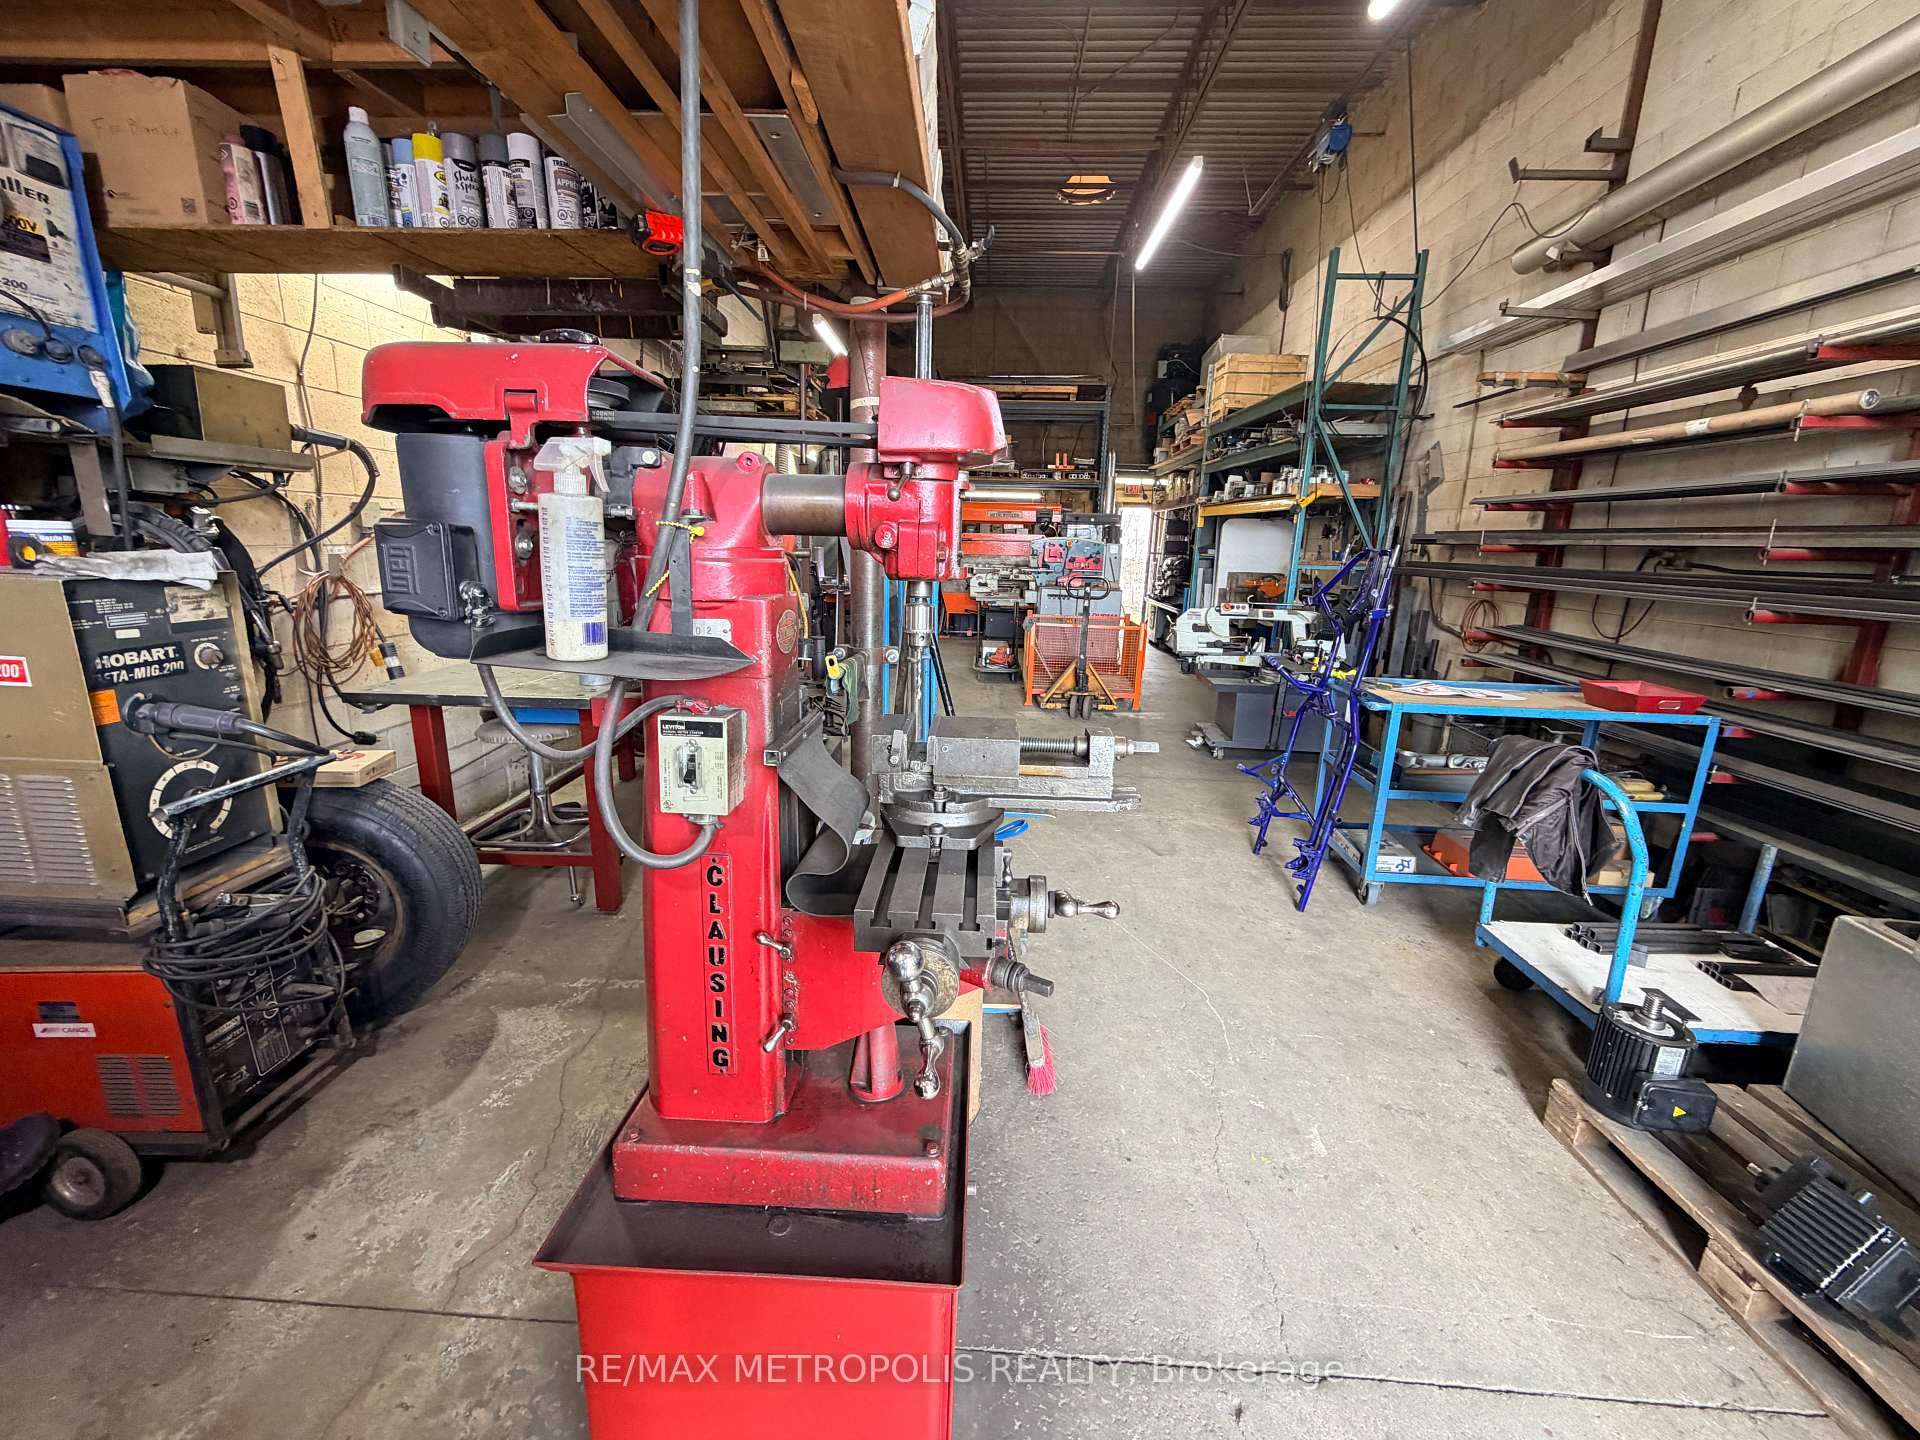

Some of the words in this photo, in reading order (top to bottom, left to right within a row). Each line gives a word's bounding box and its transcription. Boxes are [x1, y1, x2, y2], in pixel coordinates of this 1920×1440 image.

[95, 646, 177, 670] HOBART
[0, 663, 20, 679] 00
[661, 723, 686, 731] LEVITON
[706, 865, 729, 1068] CLAUSING
